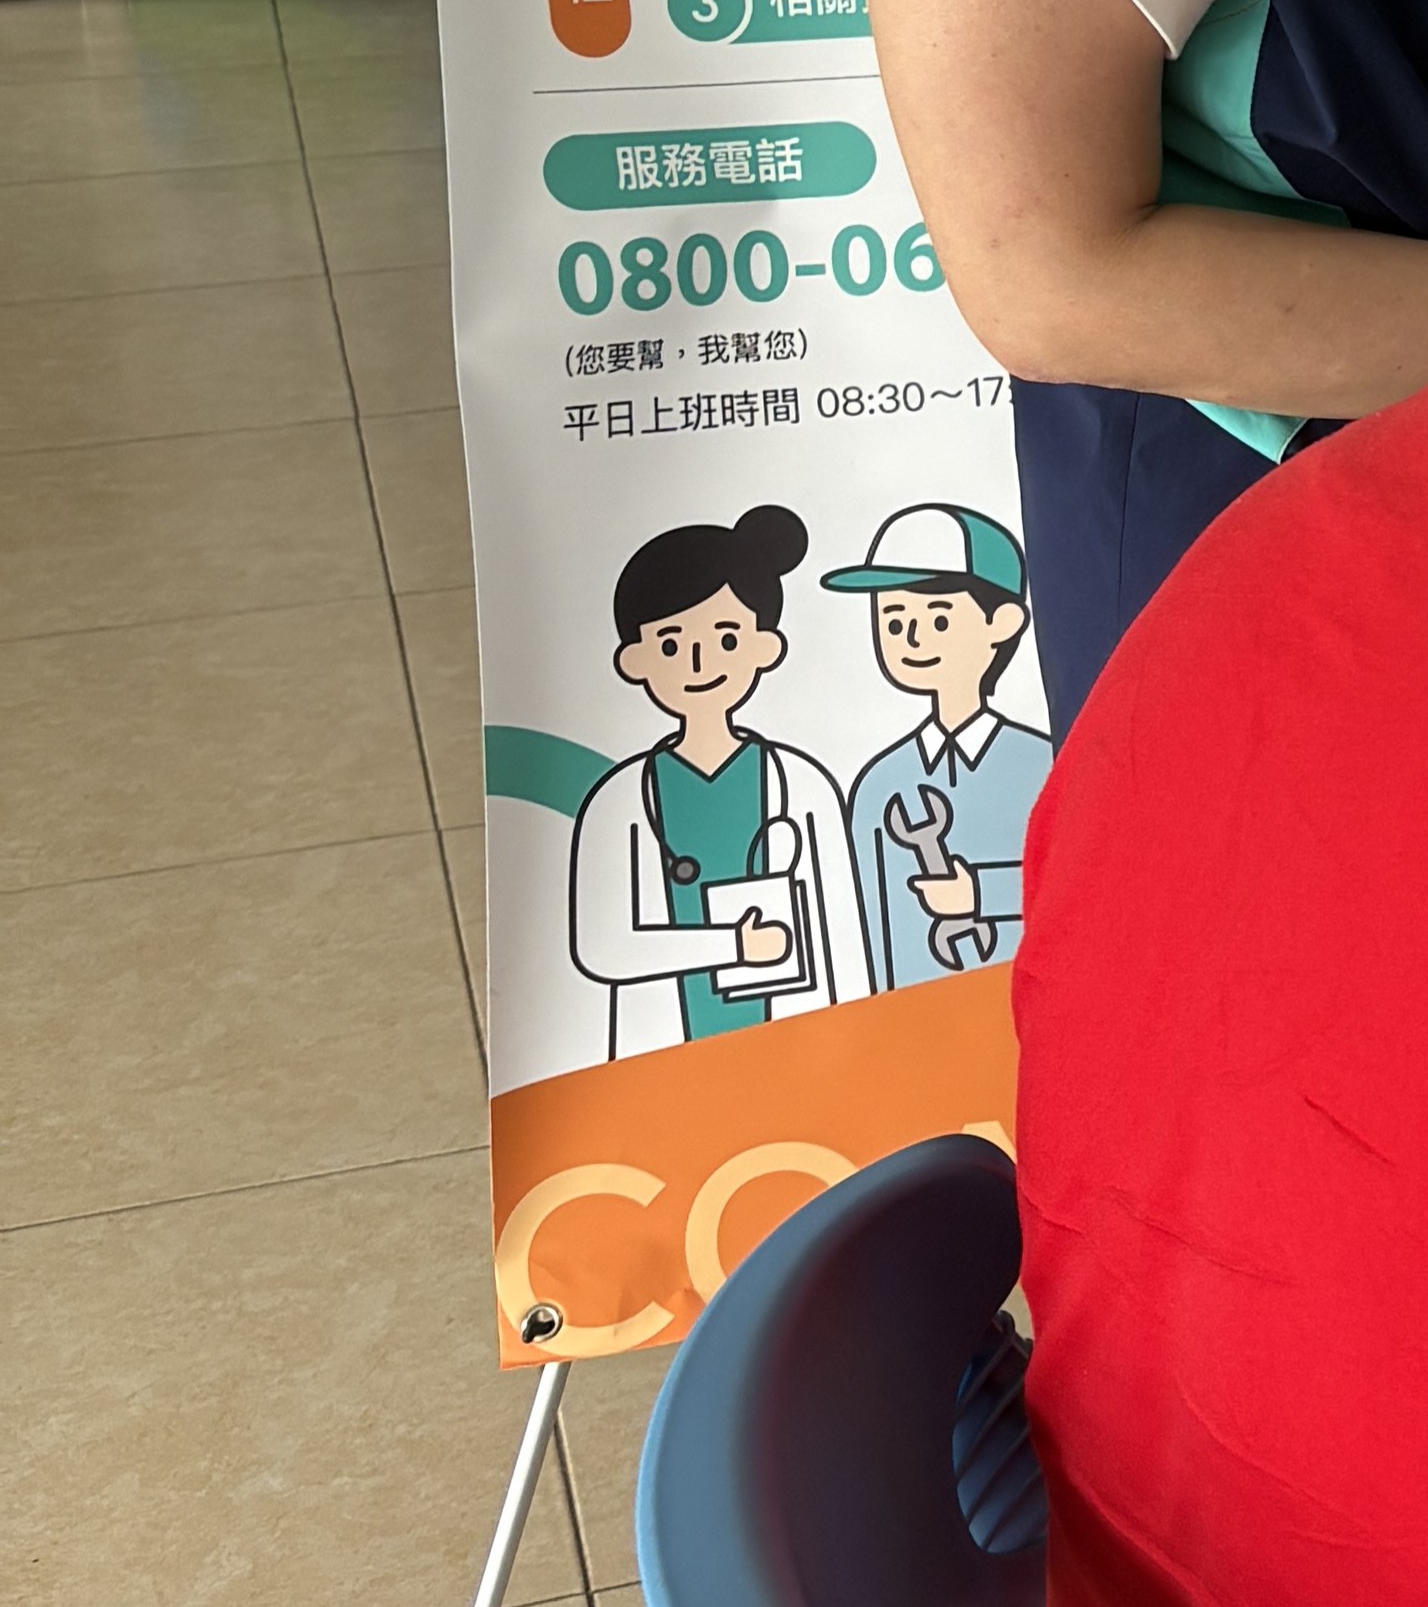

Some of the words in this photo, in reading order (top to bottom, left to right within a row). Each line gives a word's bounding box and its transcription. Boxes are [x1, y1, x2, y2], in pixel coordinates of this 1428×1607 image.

[616, 137, 803, 191] 服務電話
[558, 222, 946, 316] 0800-06
[565, 330, 808, 378] (您要幫，我幫您)
[563, 388, 800, 442] 平日上班時間
